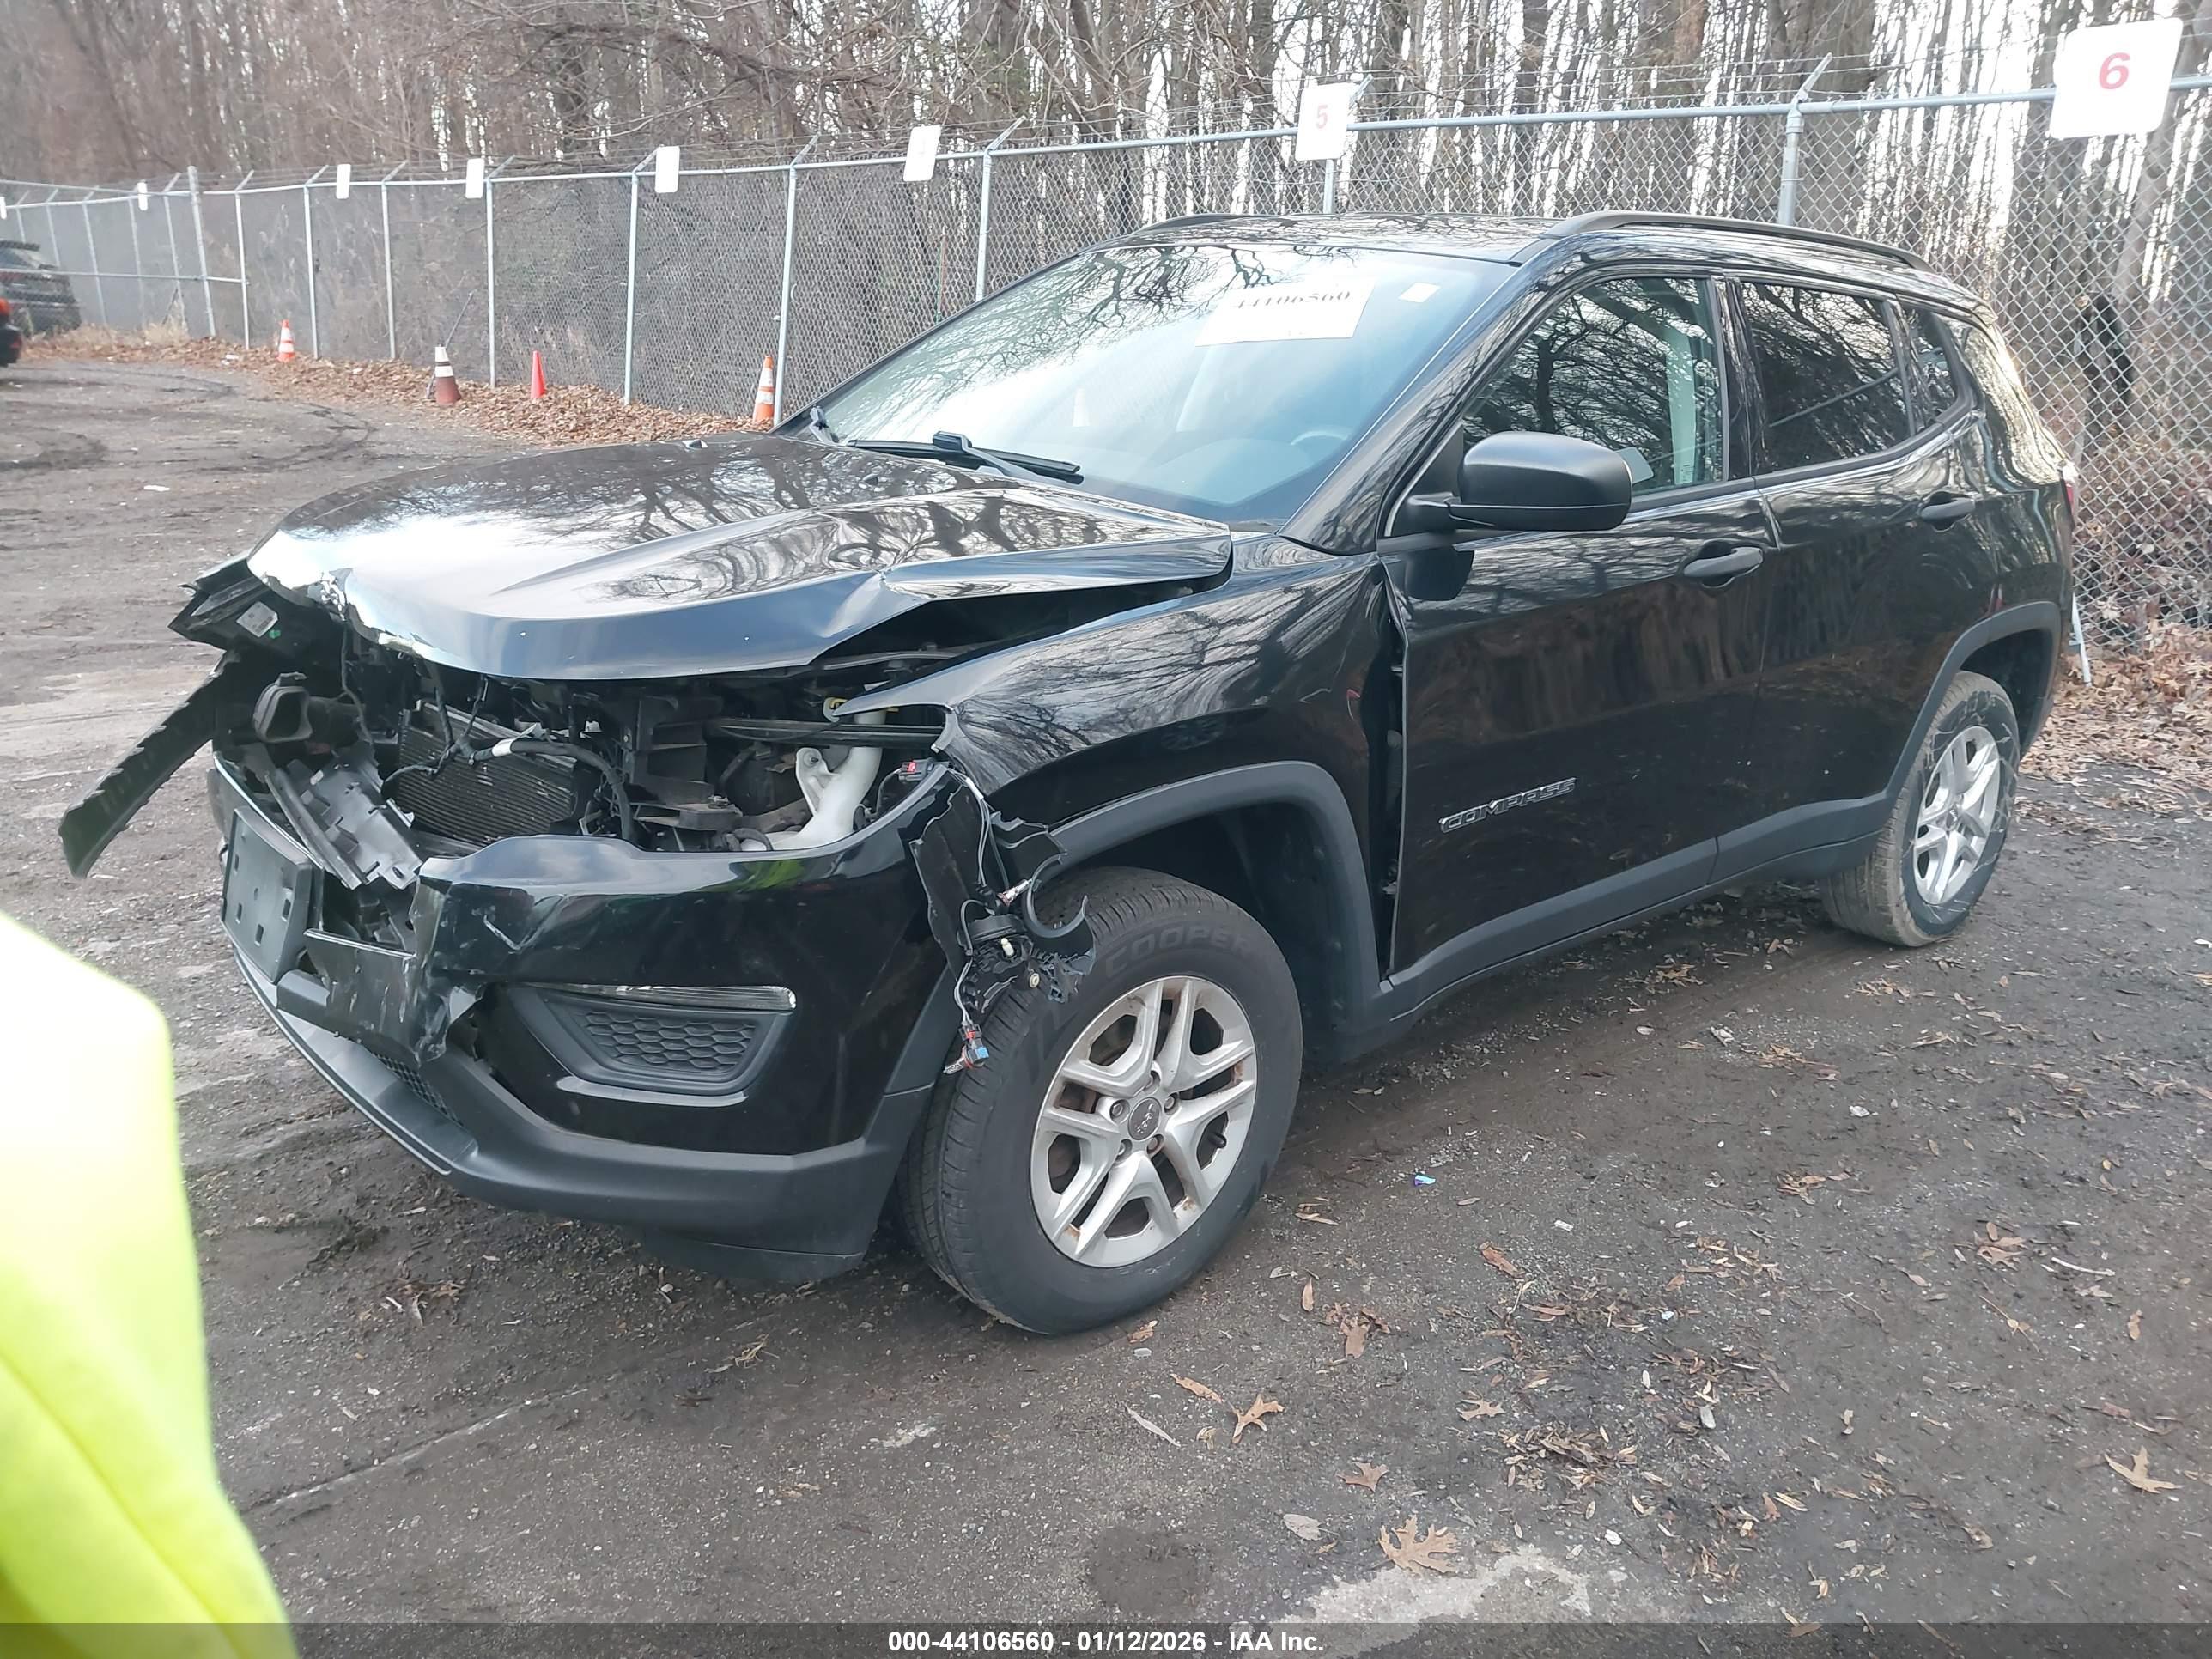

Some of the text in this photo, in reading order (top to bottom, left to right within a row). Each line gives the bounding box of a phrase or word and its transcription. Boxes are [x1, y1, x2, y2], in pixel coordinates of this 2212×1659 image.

[2099, 52, 2130, 90] 6
[1315, 104, 1329, 130] 5
[1438, 776, 1577, 834] COMPASS
[1105, 923, 1255, 980] COOPER
